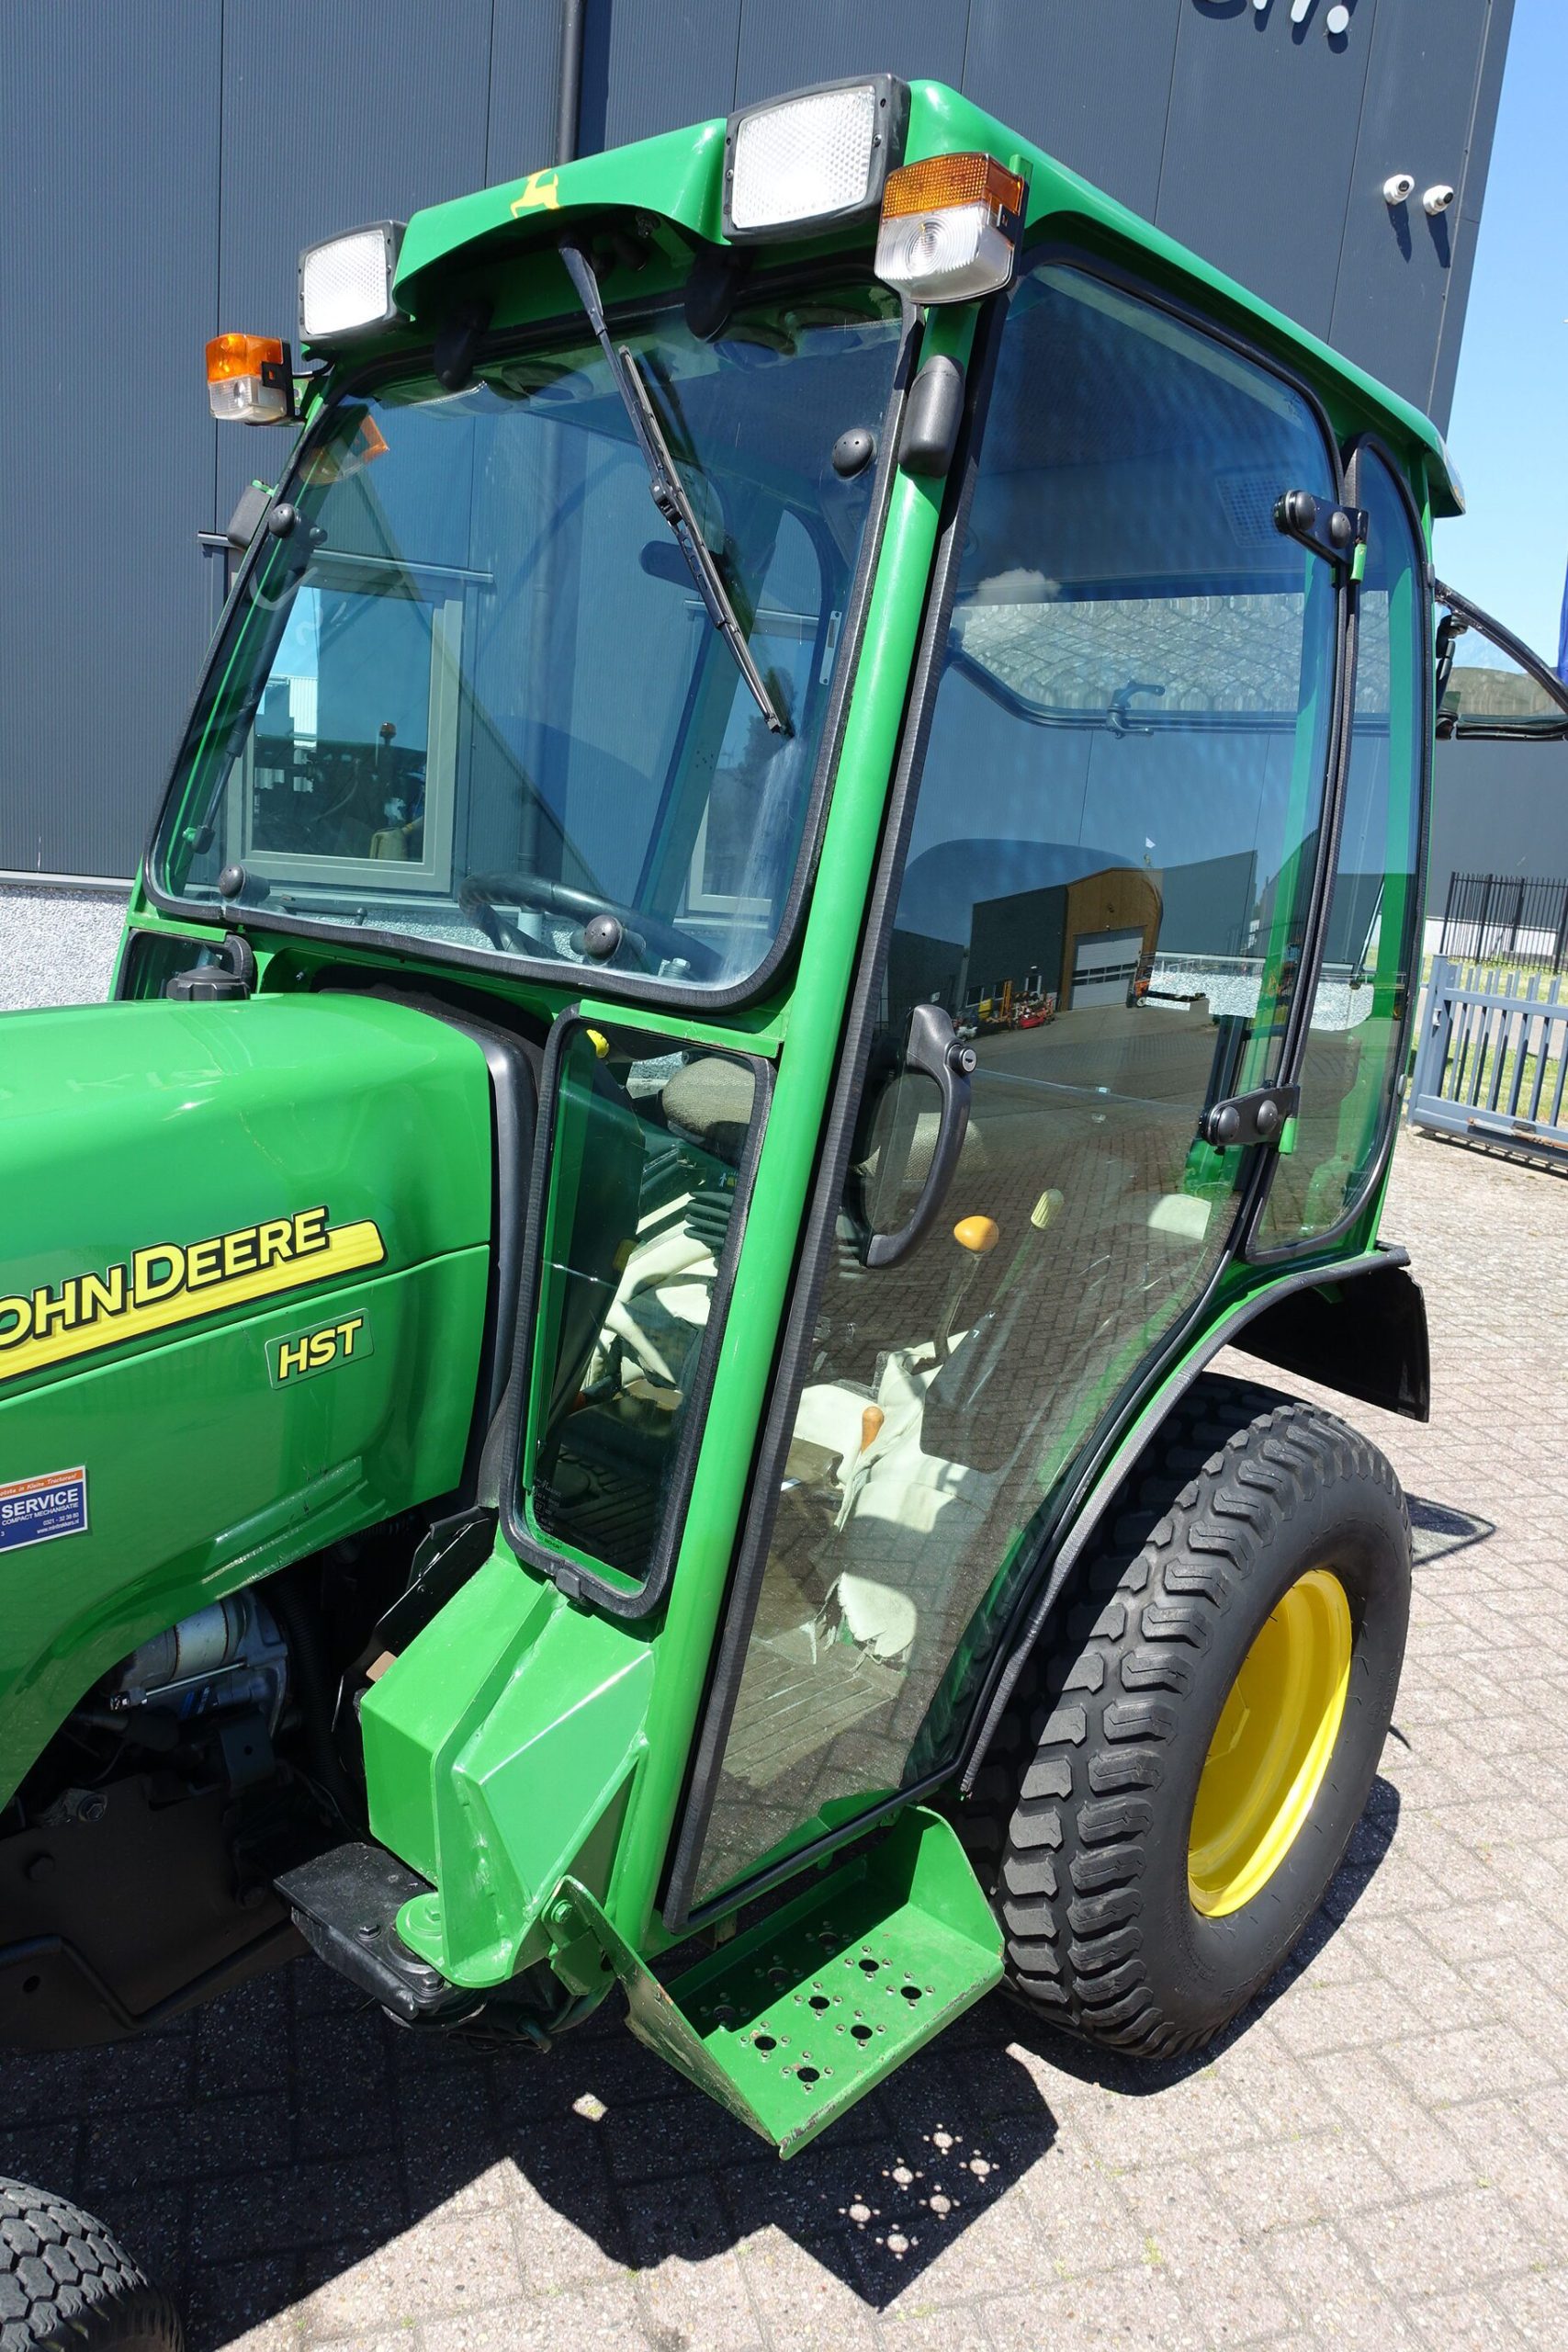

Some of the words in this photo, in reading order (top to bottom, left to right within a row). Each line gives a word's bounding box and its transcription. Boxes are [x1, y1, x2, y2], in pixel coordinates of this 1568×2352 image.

[133, 1206, 329, 1305] DEERE
[278, 1317, 364, 1380] HST
[1, 1487, 79, 1520] SERVICE
[1, 1513, 34, 1526] COMPACT
[34, 1501, 79, 1518] MECHANISATIE
